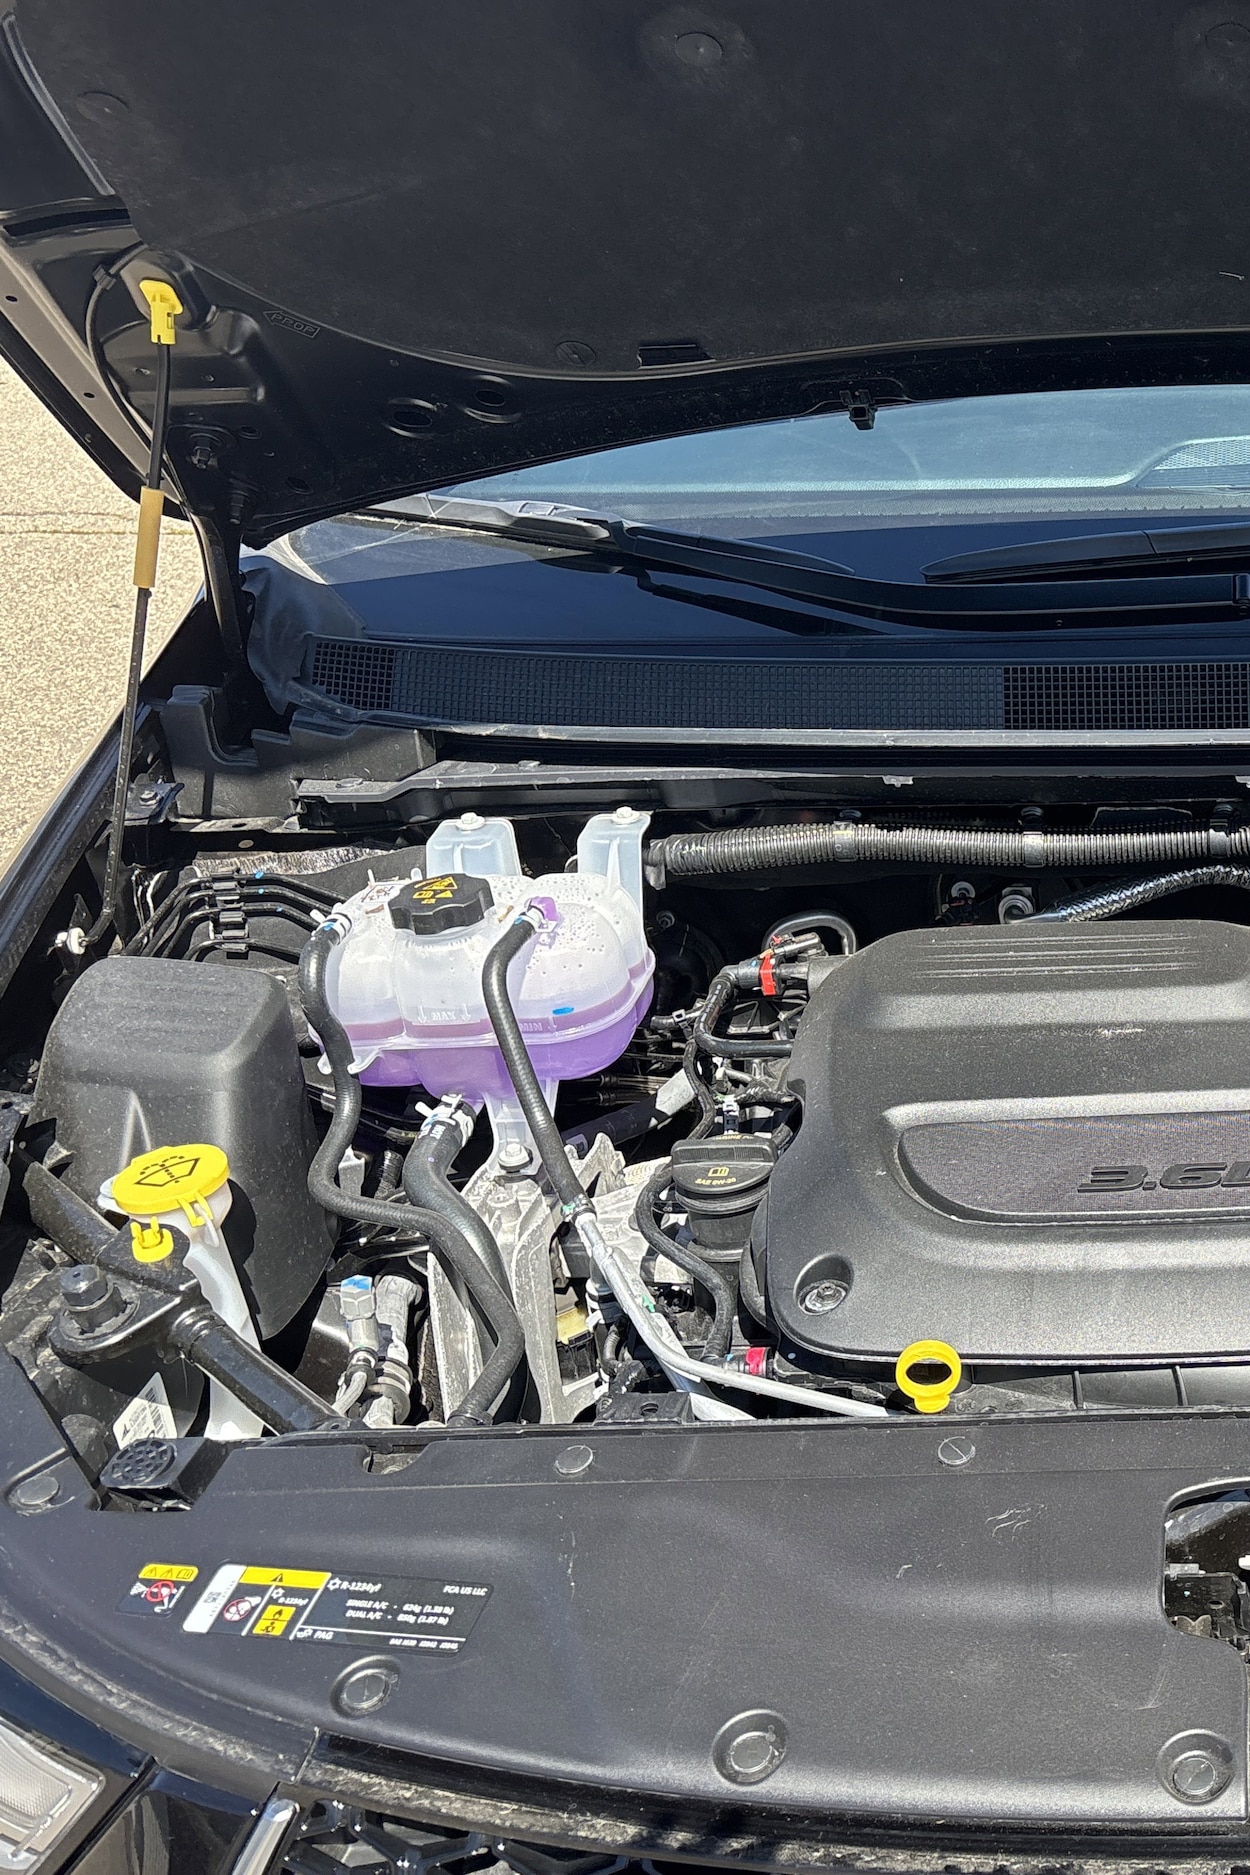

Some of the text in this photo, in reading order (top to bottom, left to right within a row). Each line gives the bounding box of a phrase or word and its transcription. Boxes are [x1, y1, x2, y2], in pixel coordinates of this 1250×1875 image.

[271, 313, 315, 334] PROP
[431, 1010, 457, 1021] MAX
[443, 1585, 488, 1596] FCA US LLC
[373, 1601, 389, 1610] A/C
[345, 1609, 367, 1618] DUAL
[366, 1611, 384, 1620] A/C
[313, 1630, 334, 1640] PAG
